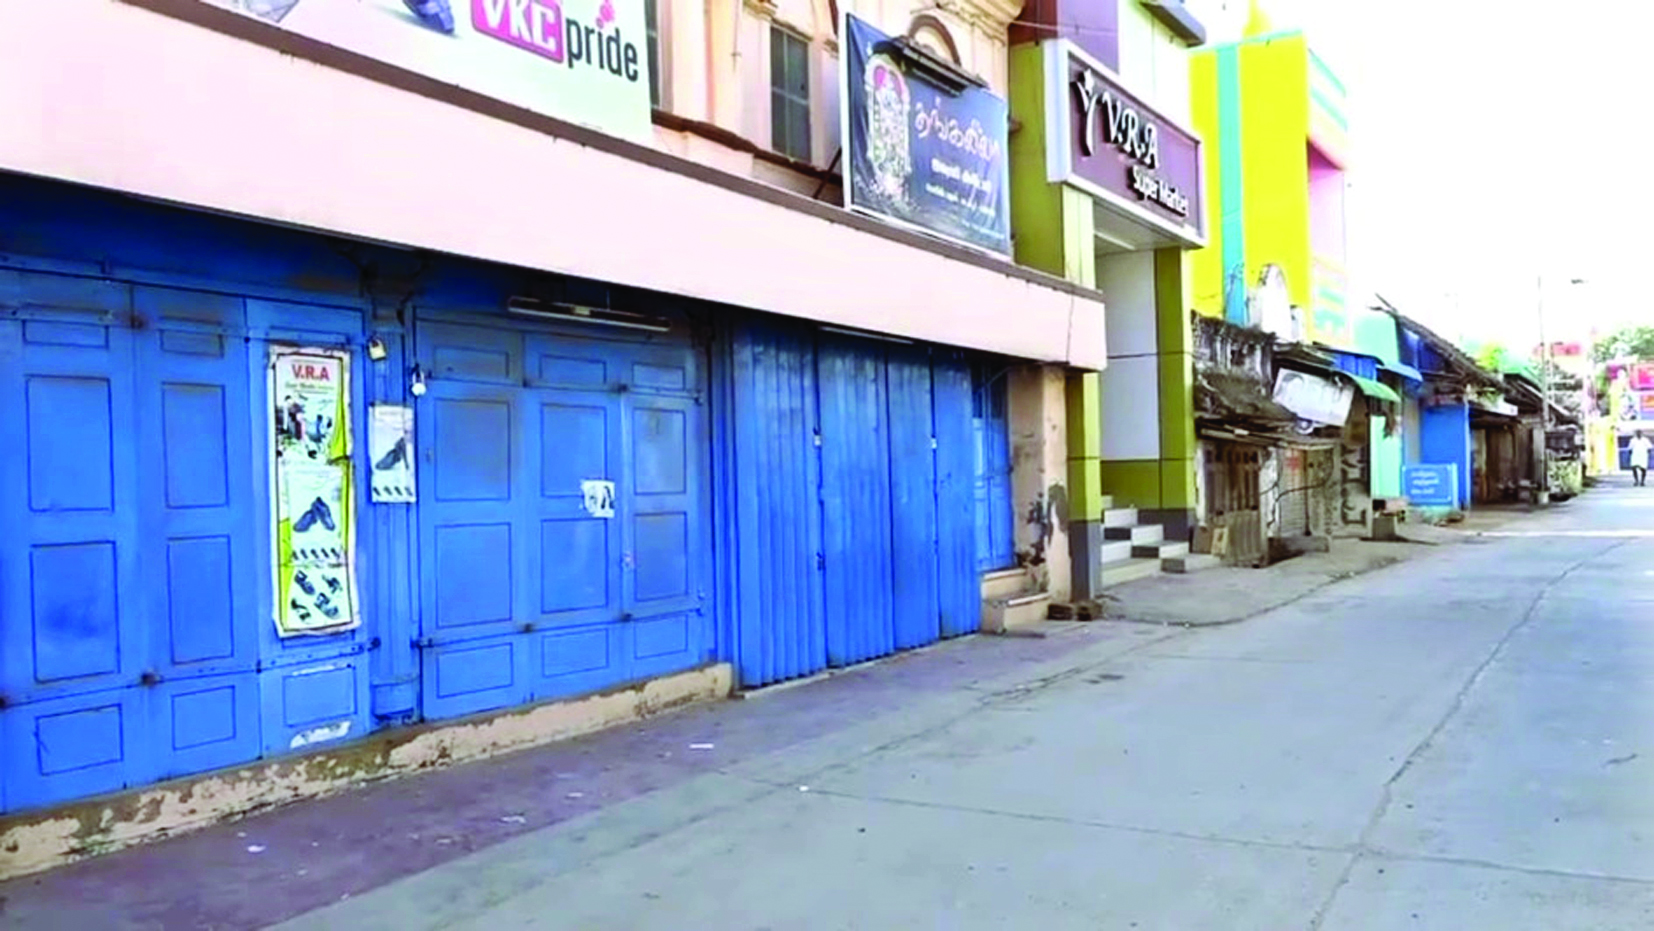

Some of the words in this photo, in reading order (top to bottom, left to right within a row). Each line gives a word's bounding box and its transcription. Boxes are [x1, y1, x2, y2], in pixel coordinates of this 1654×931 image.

[479, 0, 557, 53] VKC
[565, 17, 639, 82] pride
[1102, 91, 1160, 169] V.R.A
[1132, 165, 1159, 201] Super
[1160, 180, 1189, 217] Market
[292, 363, 330, 381] V.R.A
